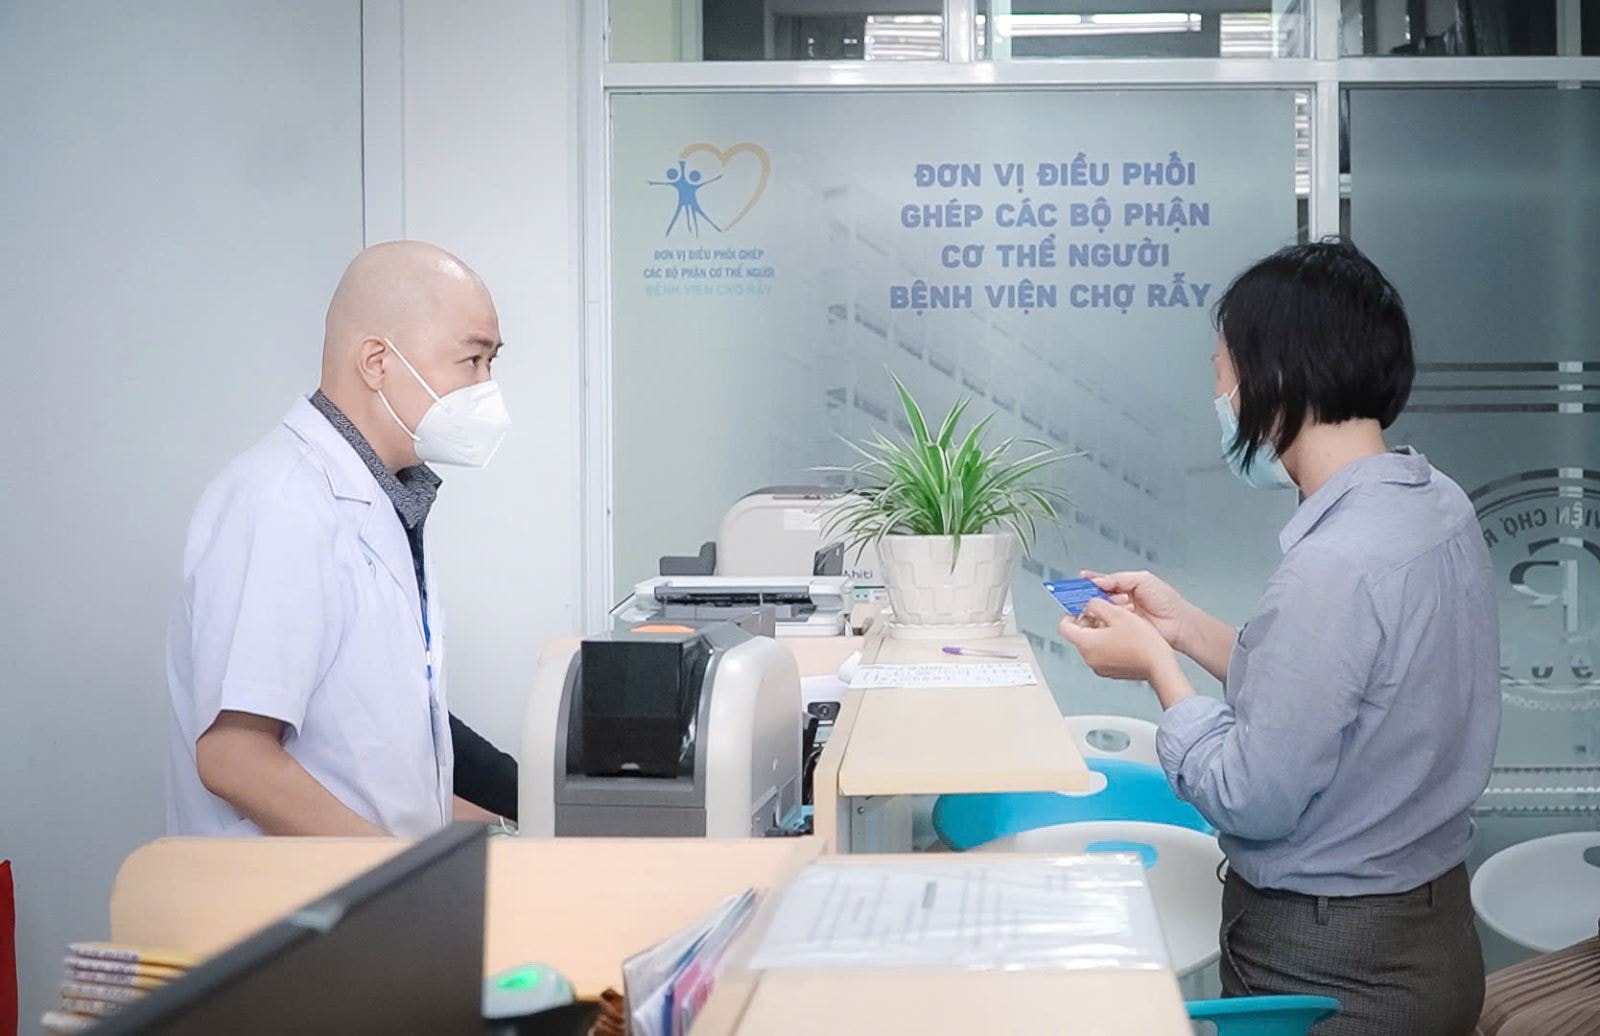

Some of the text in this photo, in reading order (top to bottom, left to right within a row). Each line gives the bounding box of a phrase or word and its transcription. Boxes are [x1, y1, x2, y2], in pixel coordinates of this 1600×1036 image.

[914, 163, 981, 187] ĐƠN
[993, 163, 1024, 193] VỊ
[1036, 151, 1110, 187] ĐIỀU
[900, 196, 1210, 233] GHÉP CÁC BỘ PHẬN
[941, 233, 1170, 269] CƠ THỂ NGƯỜI
[890, 272, 1212, 316] BỆNH VIỆN CHỢ RẪY
